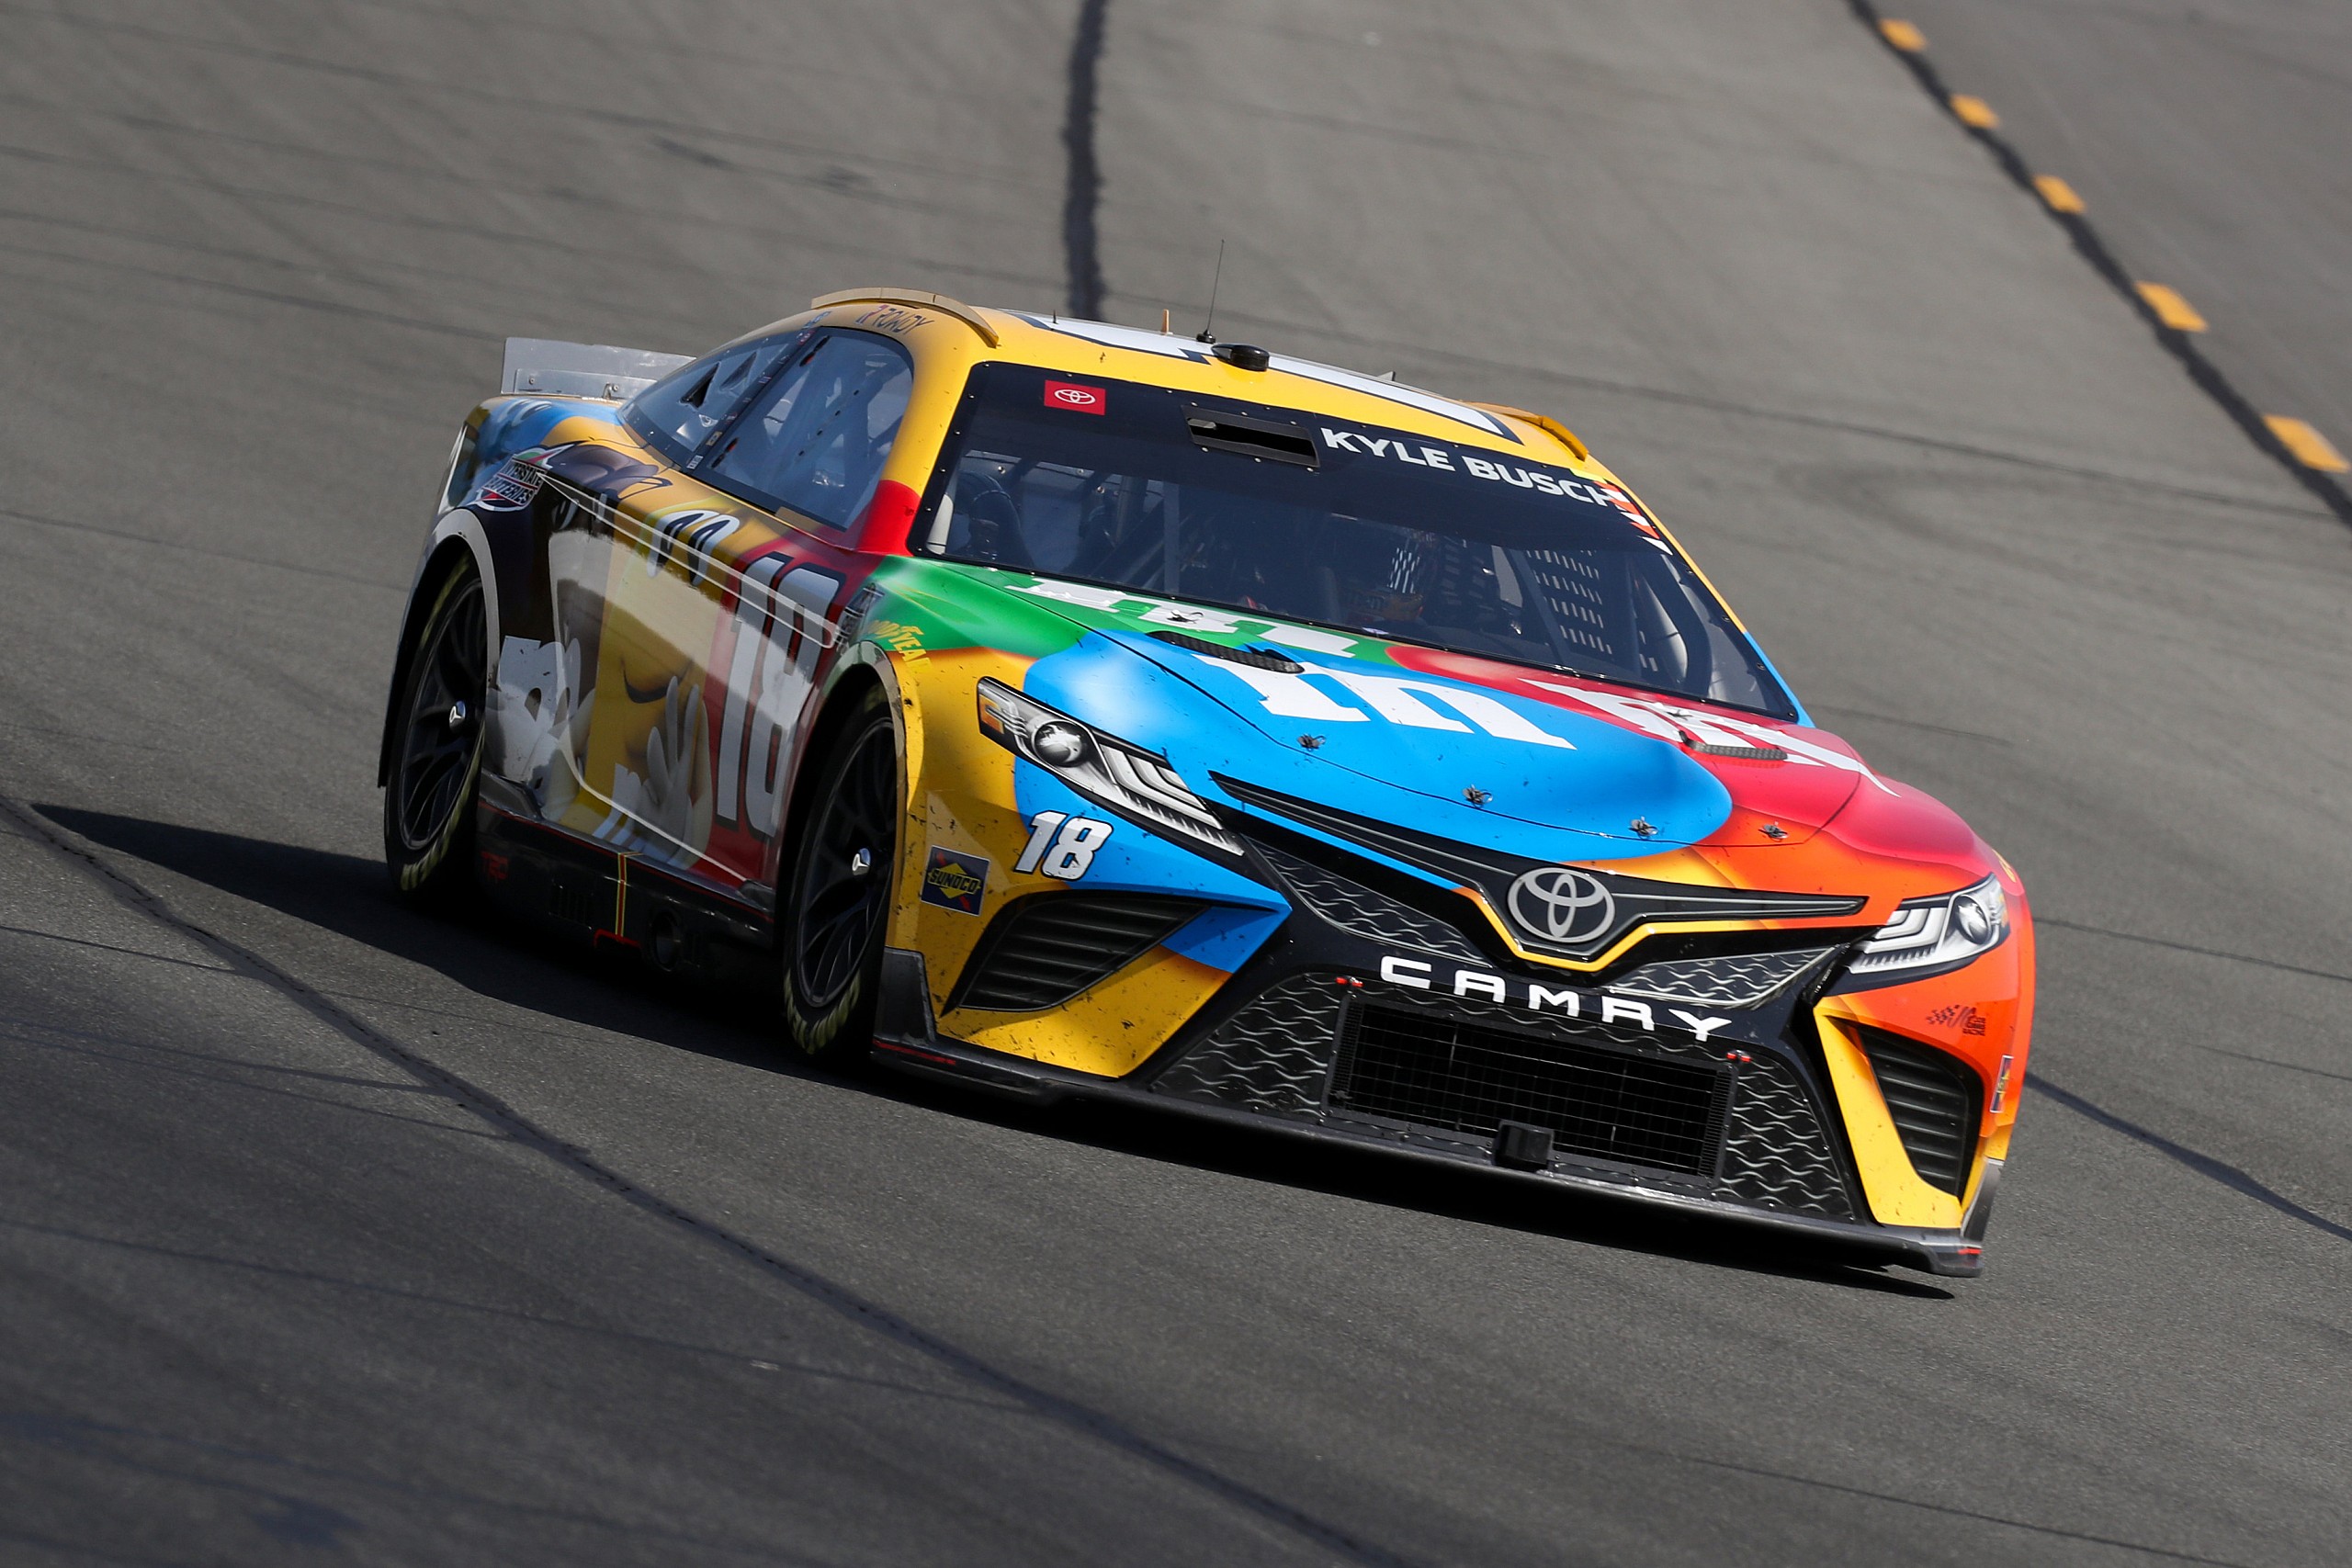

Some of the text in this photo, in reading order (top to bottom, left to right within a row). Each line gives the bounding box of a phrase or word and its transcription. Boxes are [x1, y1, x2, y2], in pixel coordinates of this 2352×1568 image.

[1320, 426, 1627, 512] KYLE BUSCH
[716, 555, 841, 839] 18
[929, 868, 981, 893] SUNOCO
[1012, 809, 1114, 882] 18
[1380, 955, 1732, 1043] CAMRY
